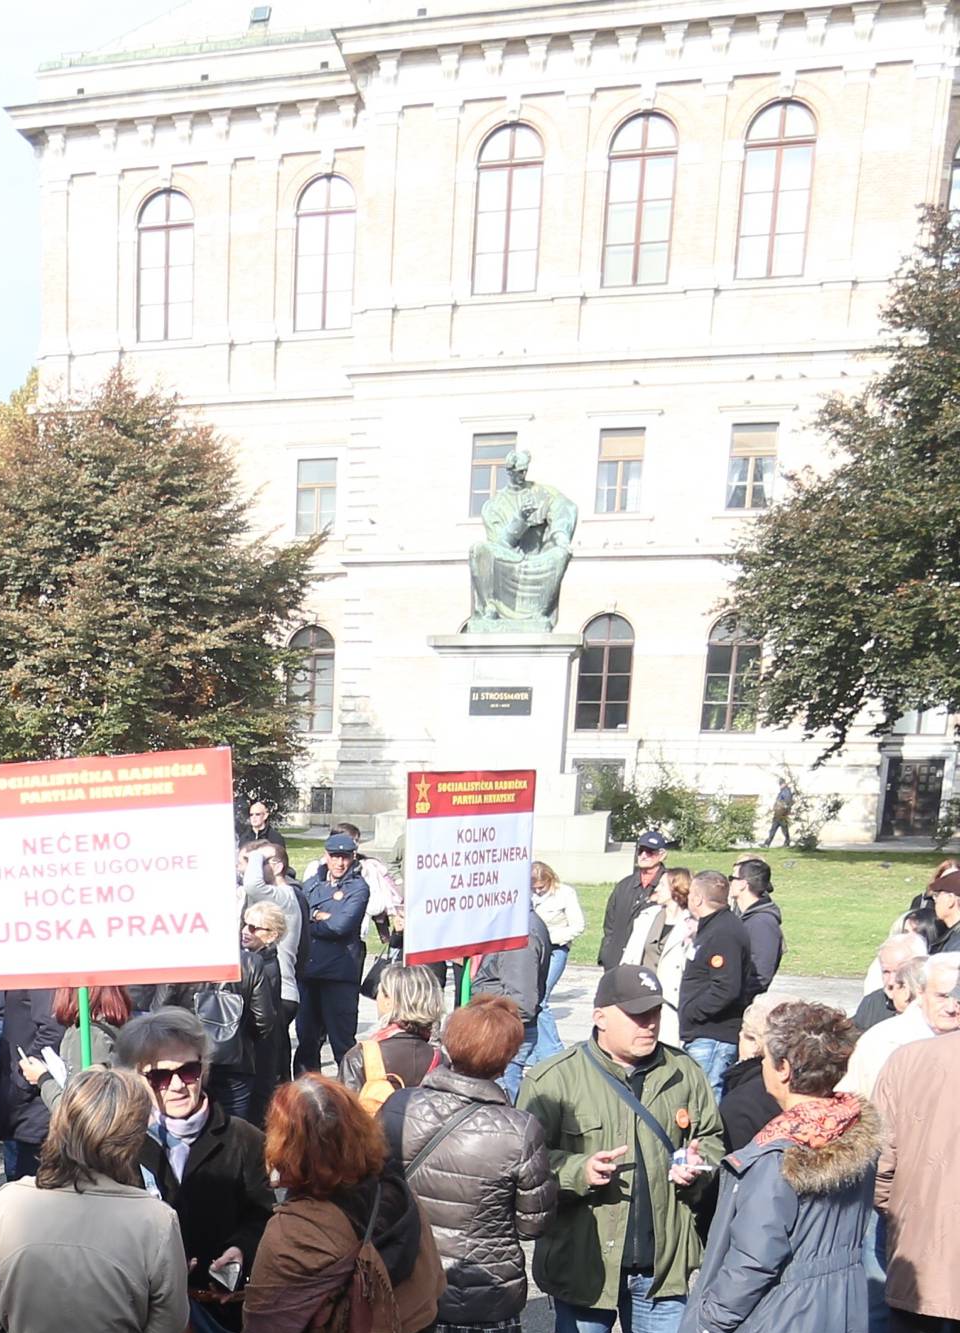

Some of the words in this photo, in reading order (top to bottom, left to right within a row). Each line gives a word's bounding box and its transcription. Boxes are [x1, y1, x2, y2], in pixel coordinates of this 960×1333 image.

[480, 691, 529, 701] STROSSMAYER
[457, 827, 496, 843] KOLIKO
[94, 855, 199, 875] UGOVORE
[416, 853, 448, 870] BOCA
[451, 852, 461, 866] IZ
[464, 847, 528, 864] KONTEJNERA
[450, 874, 464, 889] ZA
[467, 871, 499, 887] JEDAN
[425, 898, 456, 914] DVOR
[459, 896, 474, 910] OD
[476, 890, 519, 908] ONIKSA?
[107, 912, 210, 937] PRAVA
